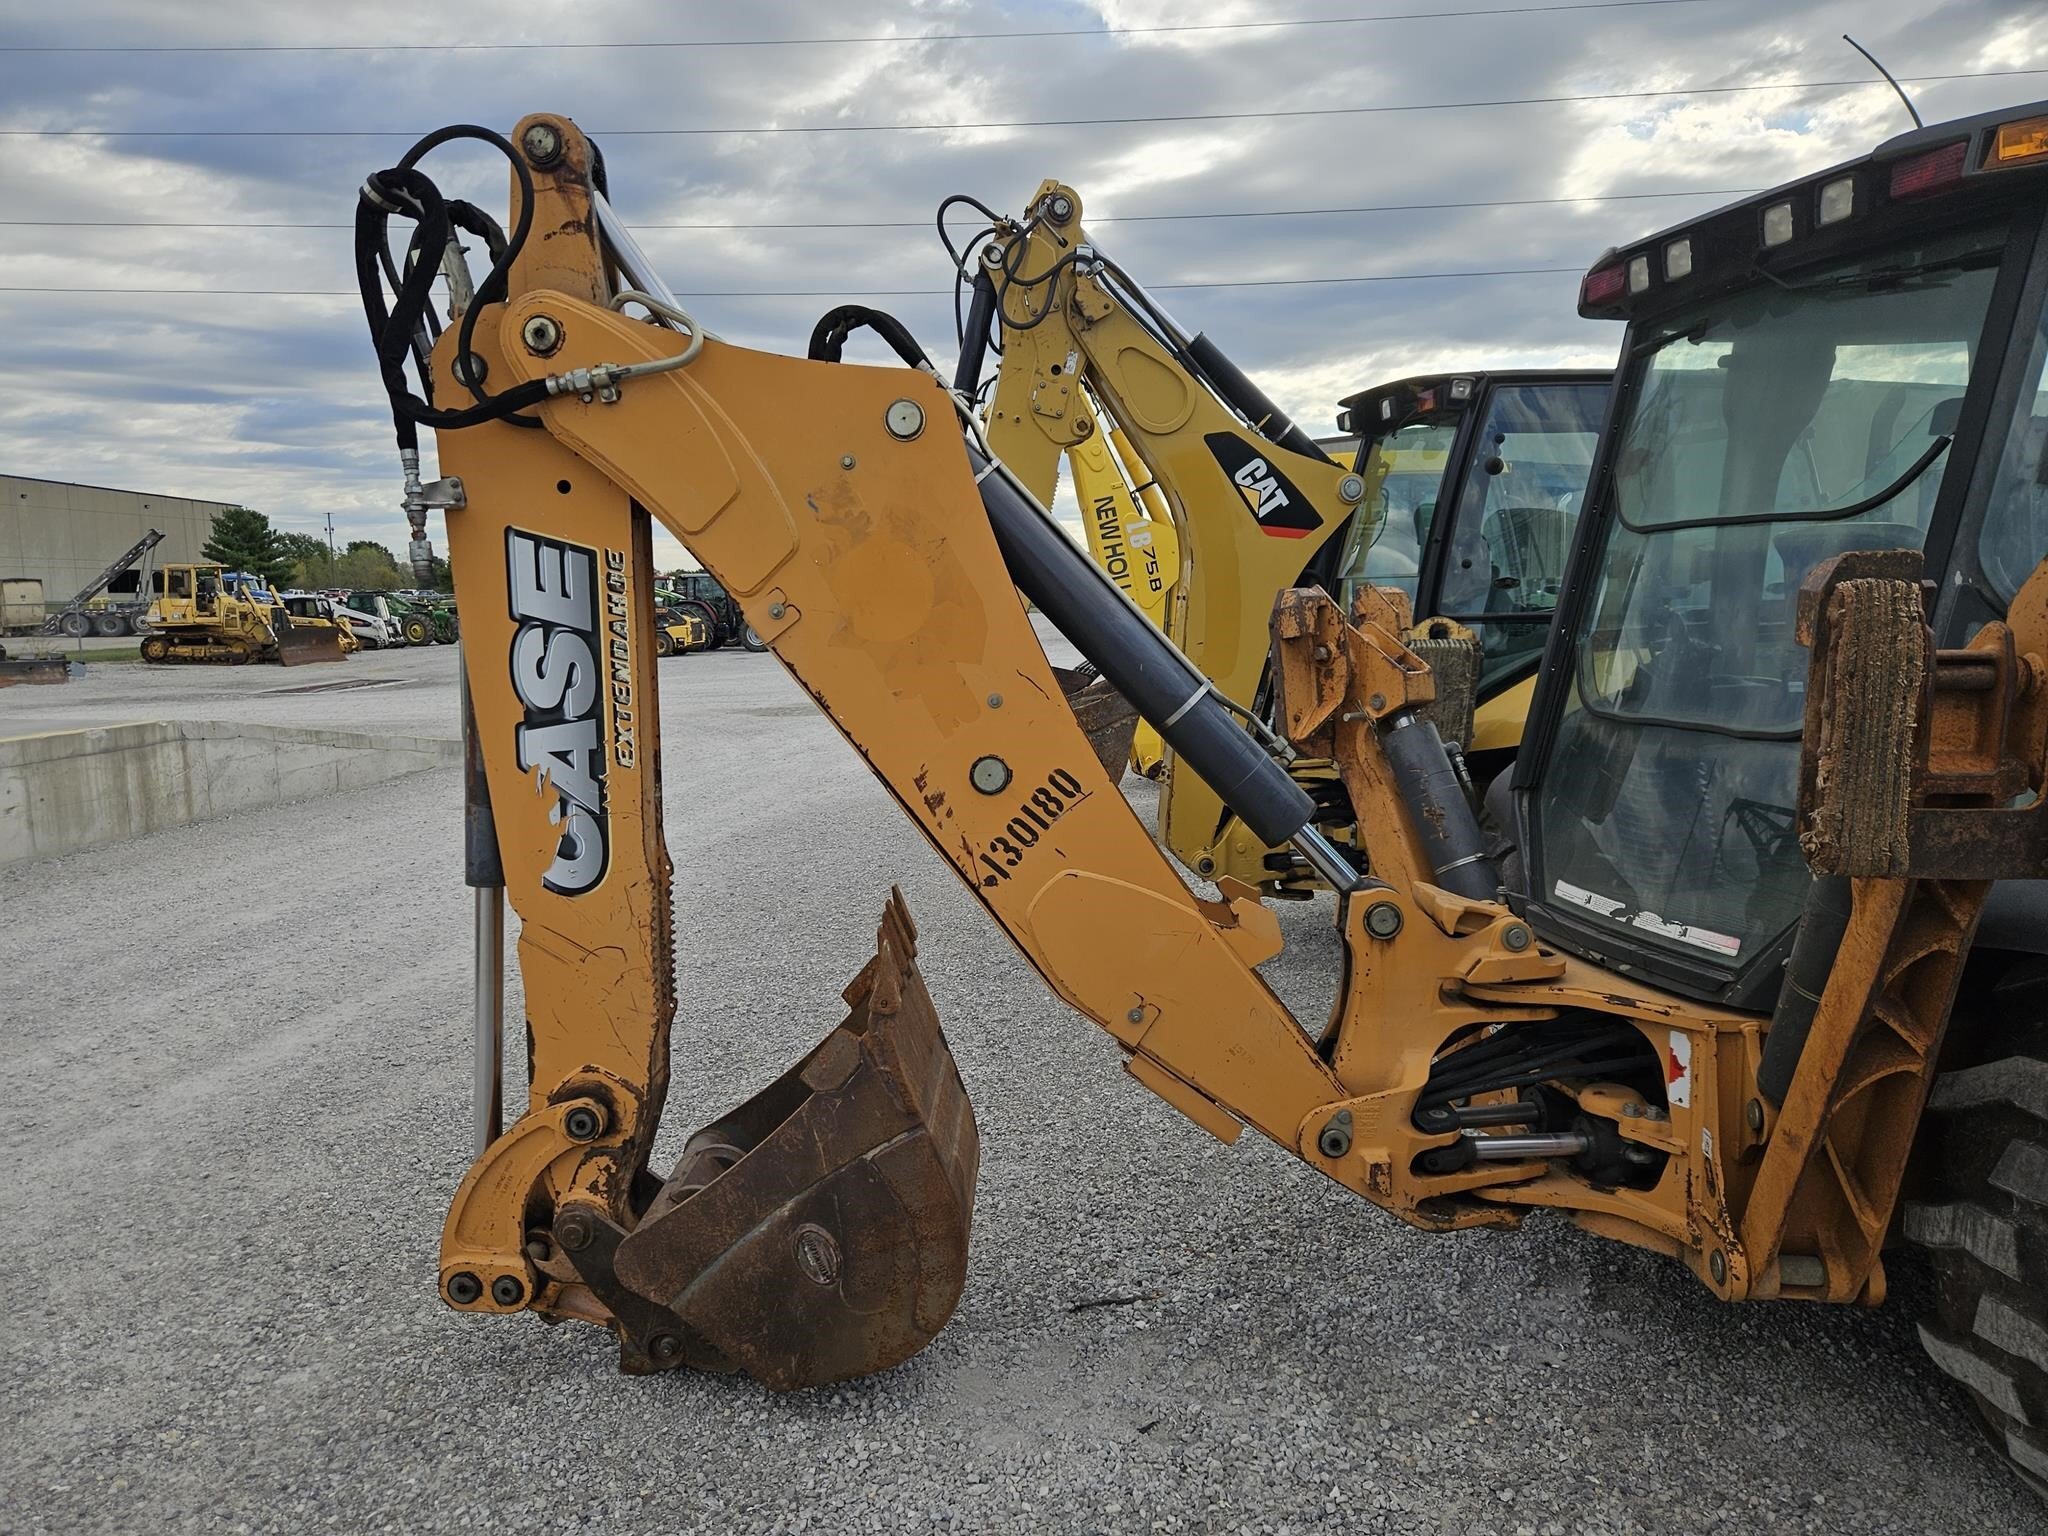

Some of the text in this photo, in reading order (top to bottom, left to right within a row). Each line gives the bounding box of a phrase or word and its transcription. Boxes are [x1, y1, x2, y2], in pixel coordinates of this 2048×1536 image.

[1093, 495, 1122, 540] NEW
[1234, 457, 1290, 519] CAT
[505, 526, 606, 893] CASE
[605, 547, 635, 769] EXTENDAHOE
